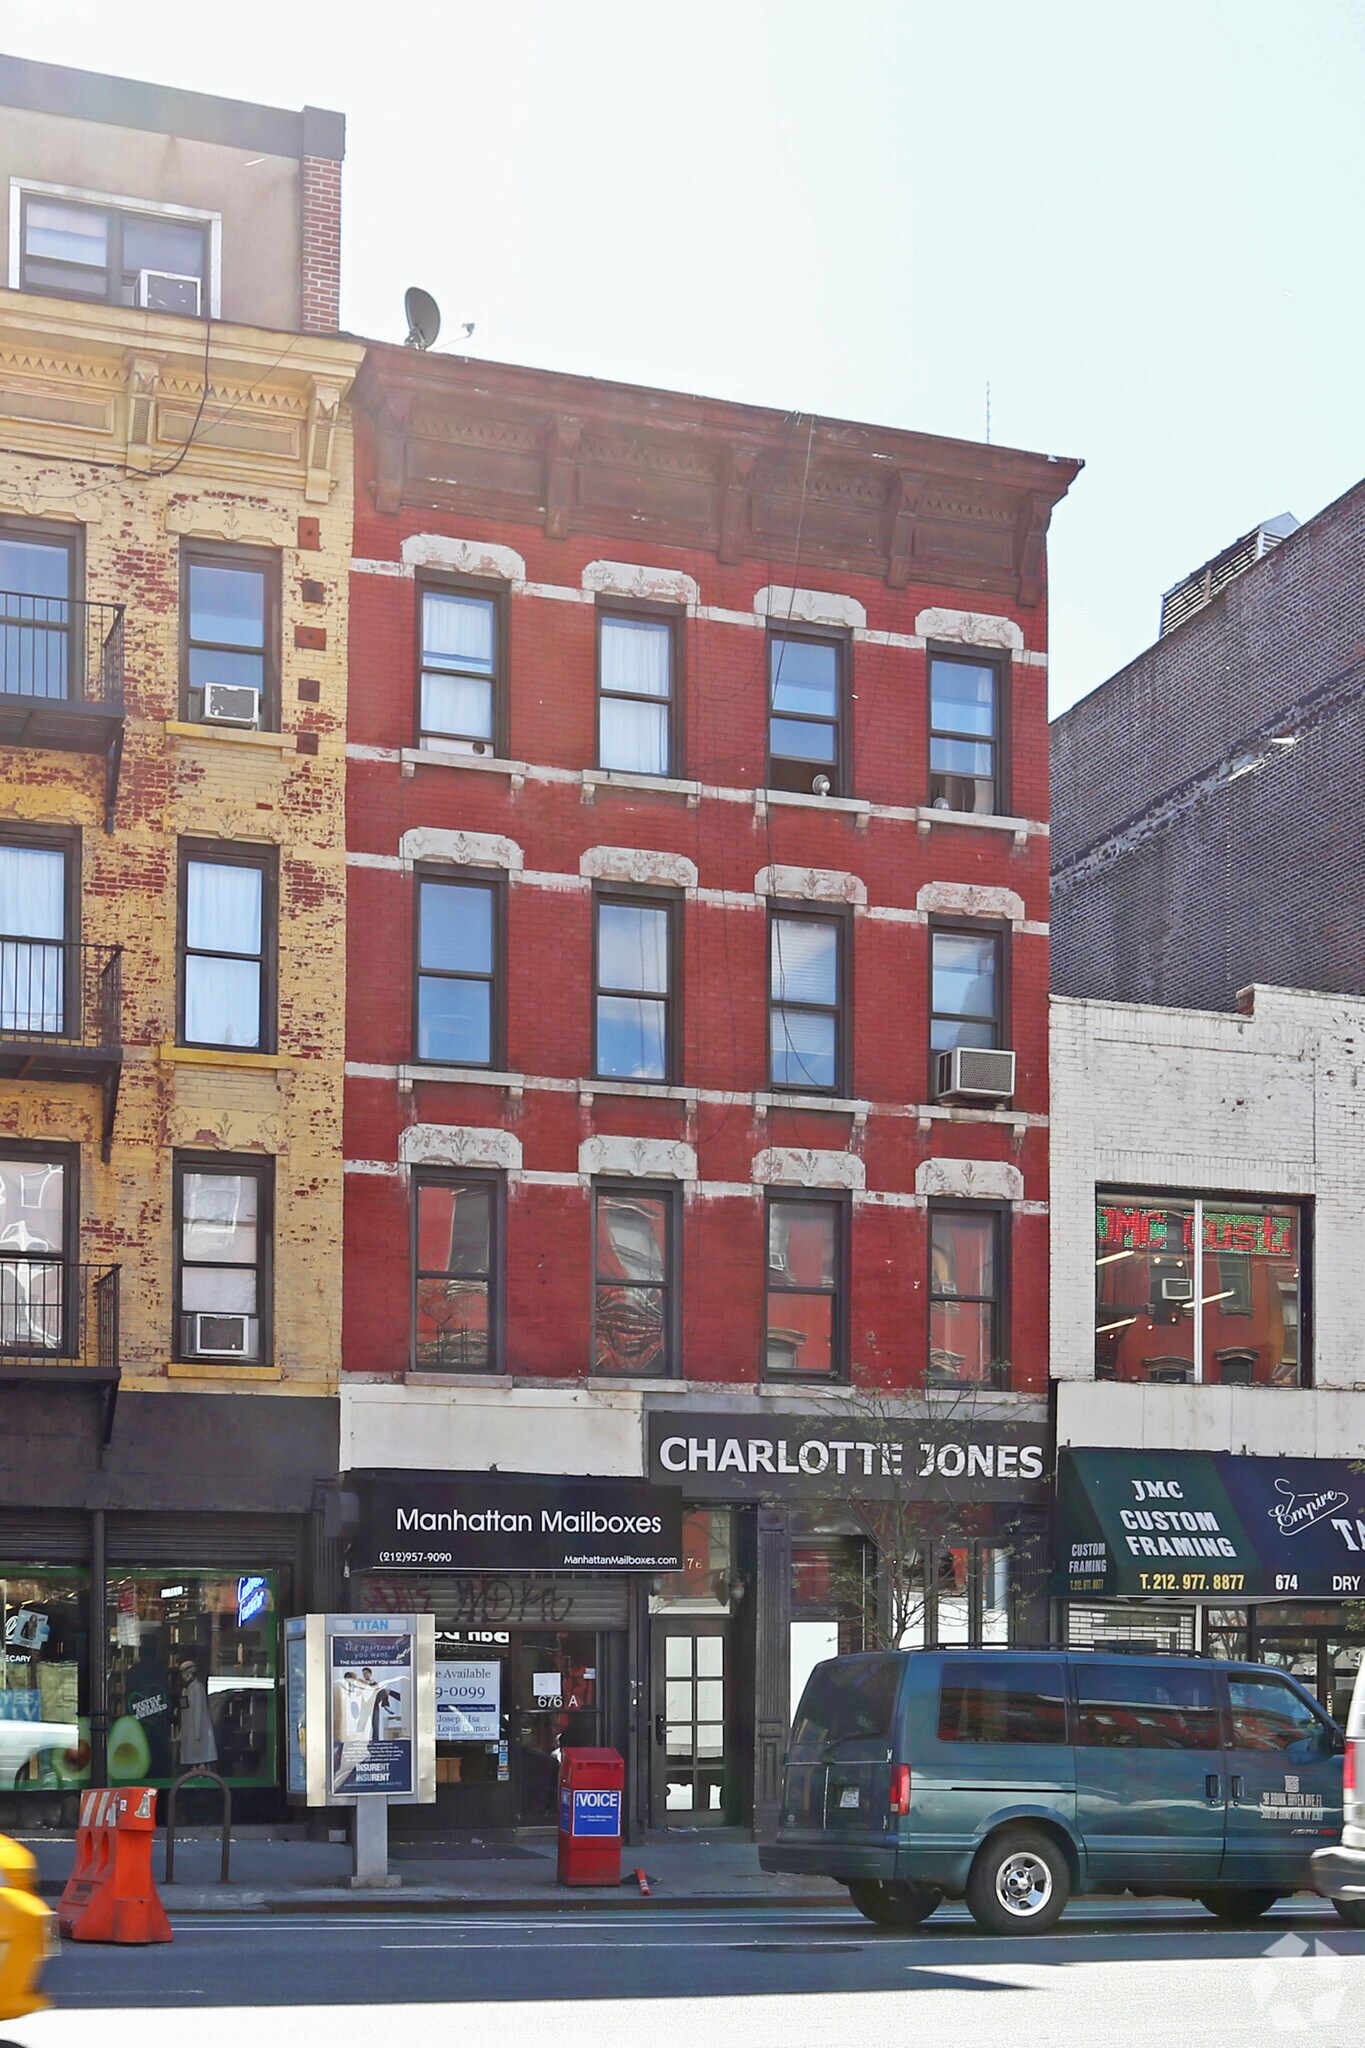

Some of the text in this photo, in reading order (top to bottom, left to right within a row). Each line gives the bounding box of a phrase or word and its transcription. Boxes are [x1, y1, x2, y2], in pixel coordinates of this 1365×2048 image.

[1097, 1207, 1167, 1248] JMC
[659, 1436, 1043, 1479] CHARLOTTE JONES
[1131, 1480, 1184, 1501] JMC
[1268, 1488, 1338, 1527] Empire
[396, 1508, 662, 1534] Manhattan Mailboxes
[1119, 1509, 1220, 1532] CUSTOM
[1071, 1542, 1106, 1557] CUSTOM
[1125, 1535, 1237, 1558] FRAMING
[379, 1551, 452, 1564] (212)957-9090
[563, 1555, 678, 1566] ManhattanMailboxes.com
[1069, 1559, 1107, 1574] FRAMING
[1275, 1574, 1298, 1590] 674
[1332, 1575, 1360, 1591] DRY
[352, 1619, 389, 1630] TITAN
[360, 1644, 400, 1653] apartment
[354, 1652, 368, 1660] you
[444, 1668, 491, 1679] Available
[537, 1694, 579, 1708] 676 A
[468, 1715, 480, 1723] Isa
[438, 1724, 460, 1732] Louis
[355, 1762, 391, 1772] INSURENT
[355, 1772, 391, 1782] INSURENT
[579, 1793, 618, 1807] VOICE
